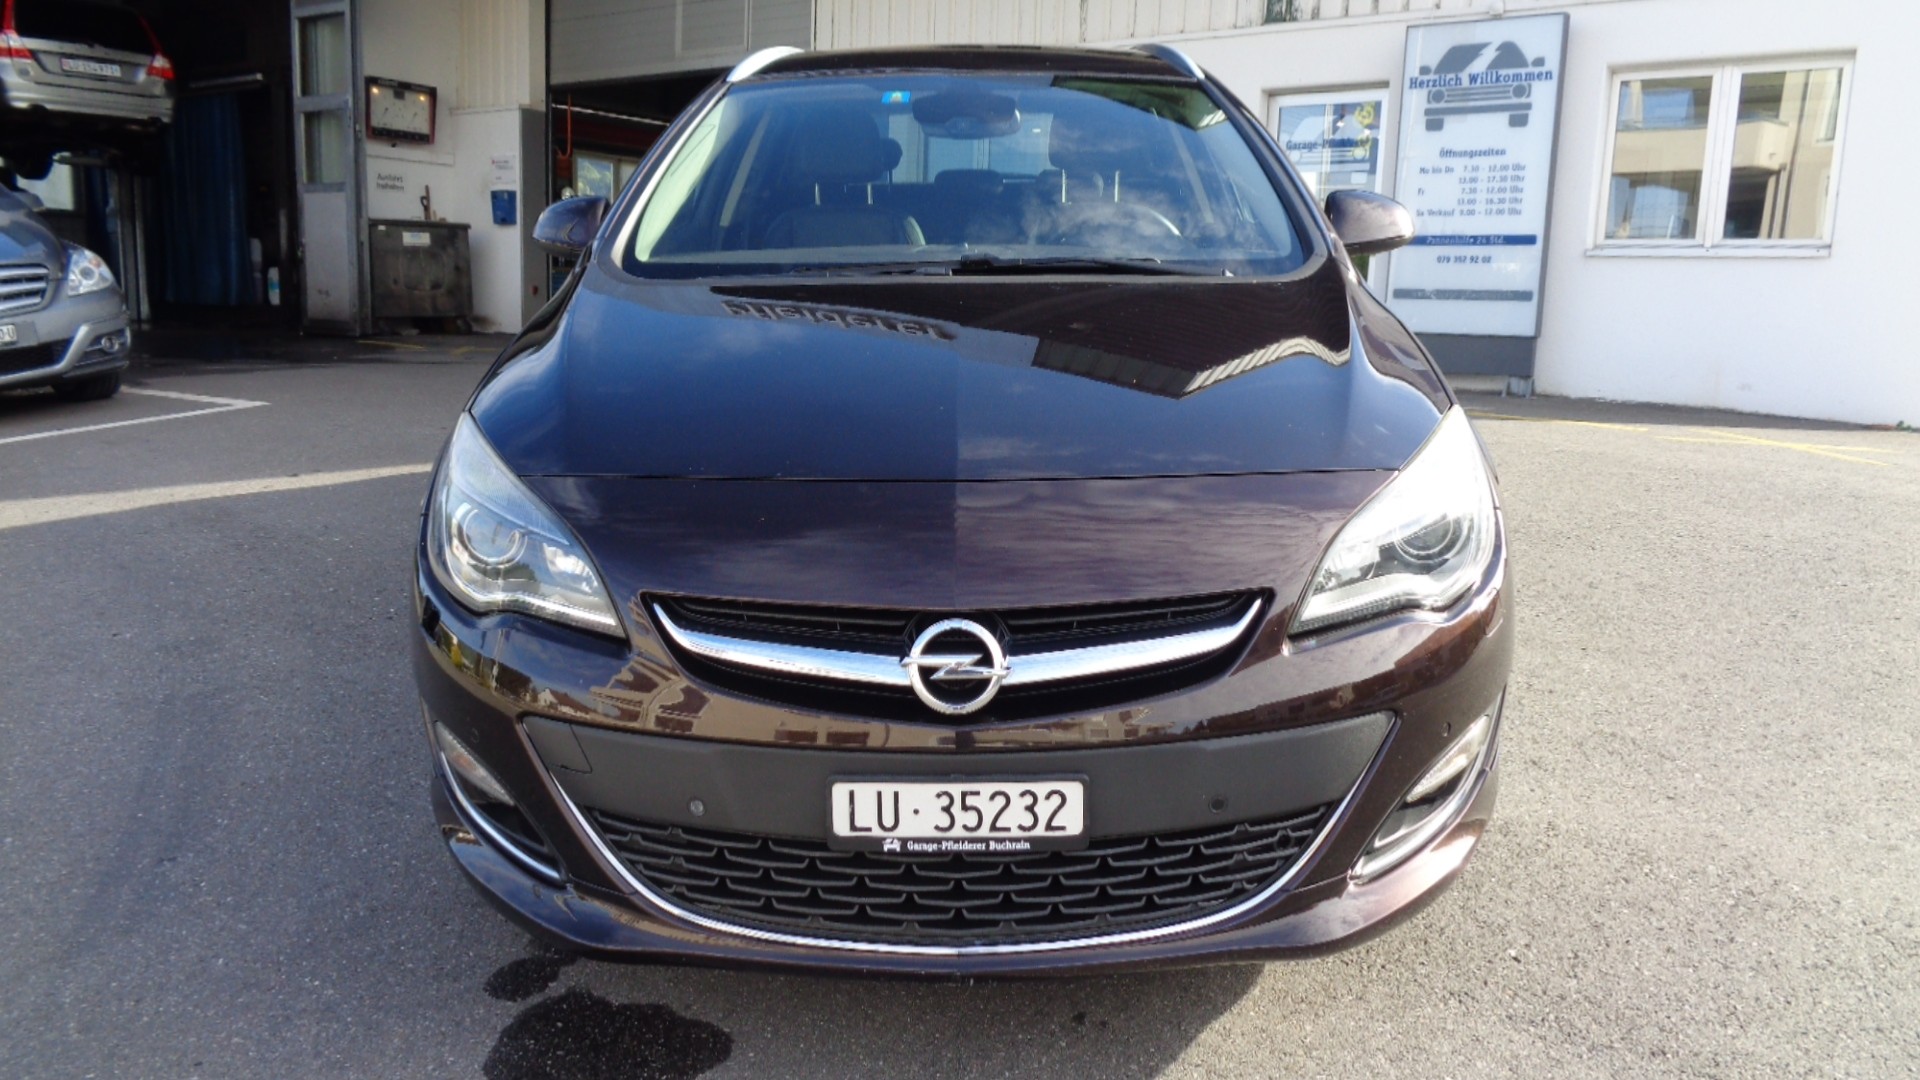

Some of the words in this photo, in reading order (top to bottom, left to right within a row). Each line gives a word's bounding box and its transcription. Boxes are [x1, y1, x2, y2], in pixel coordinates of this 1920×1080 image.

[1409, 73, 1462, 89] Herzlich
[1468, 70, 1553, 86] Willkommen
[1439, 147, 1506, 159] Öffnungszeiten
[1427, 209, 1455, 217] Verkauf
[907, 840, 986, 852] Garage-Pfleiderer
[989, 839, 1030, 850] Buchrain
